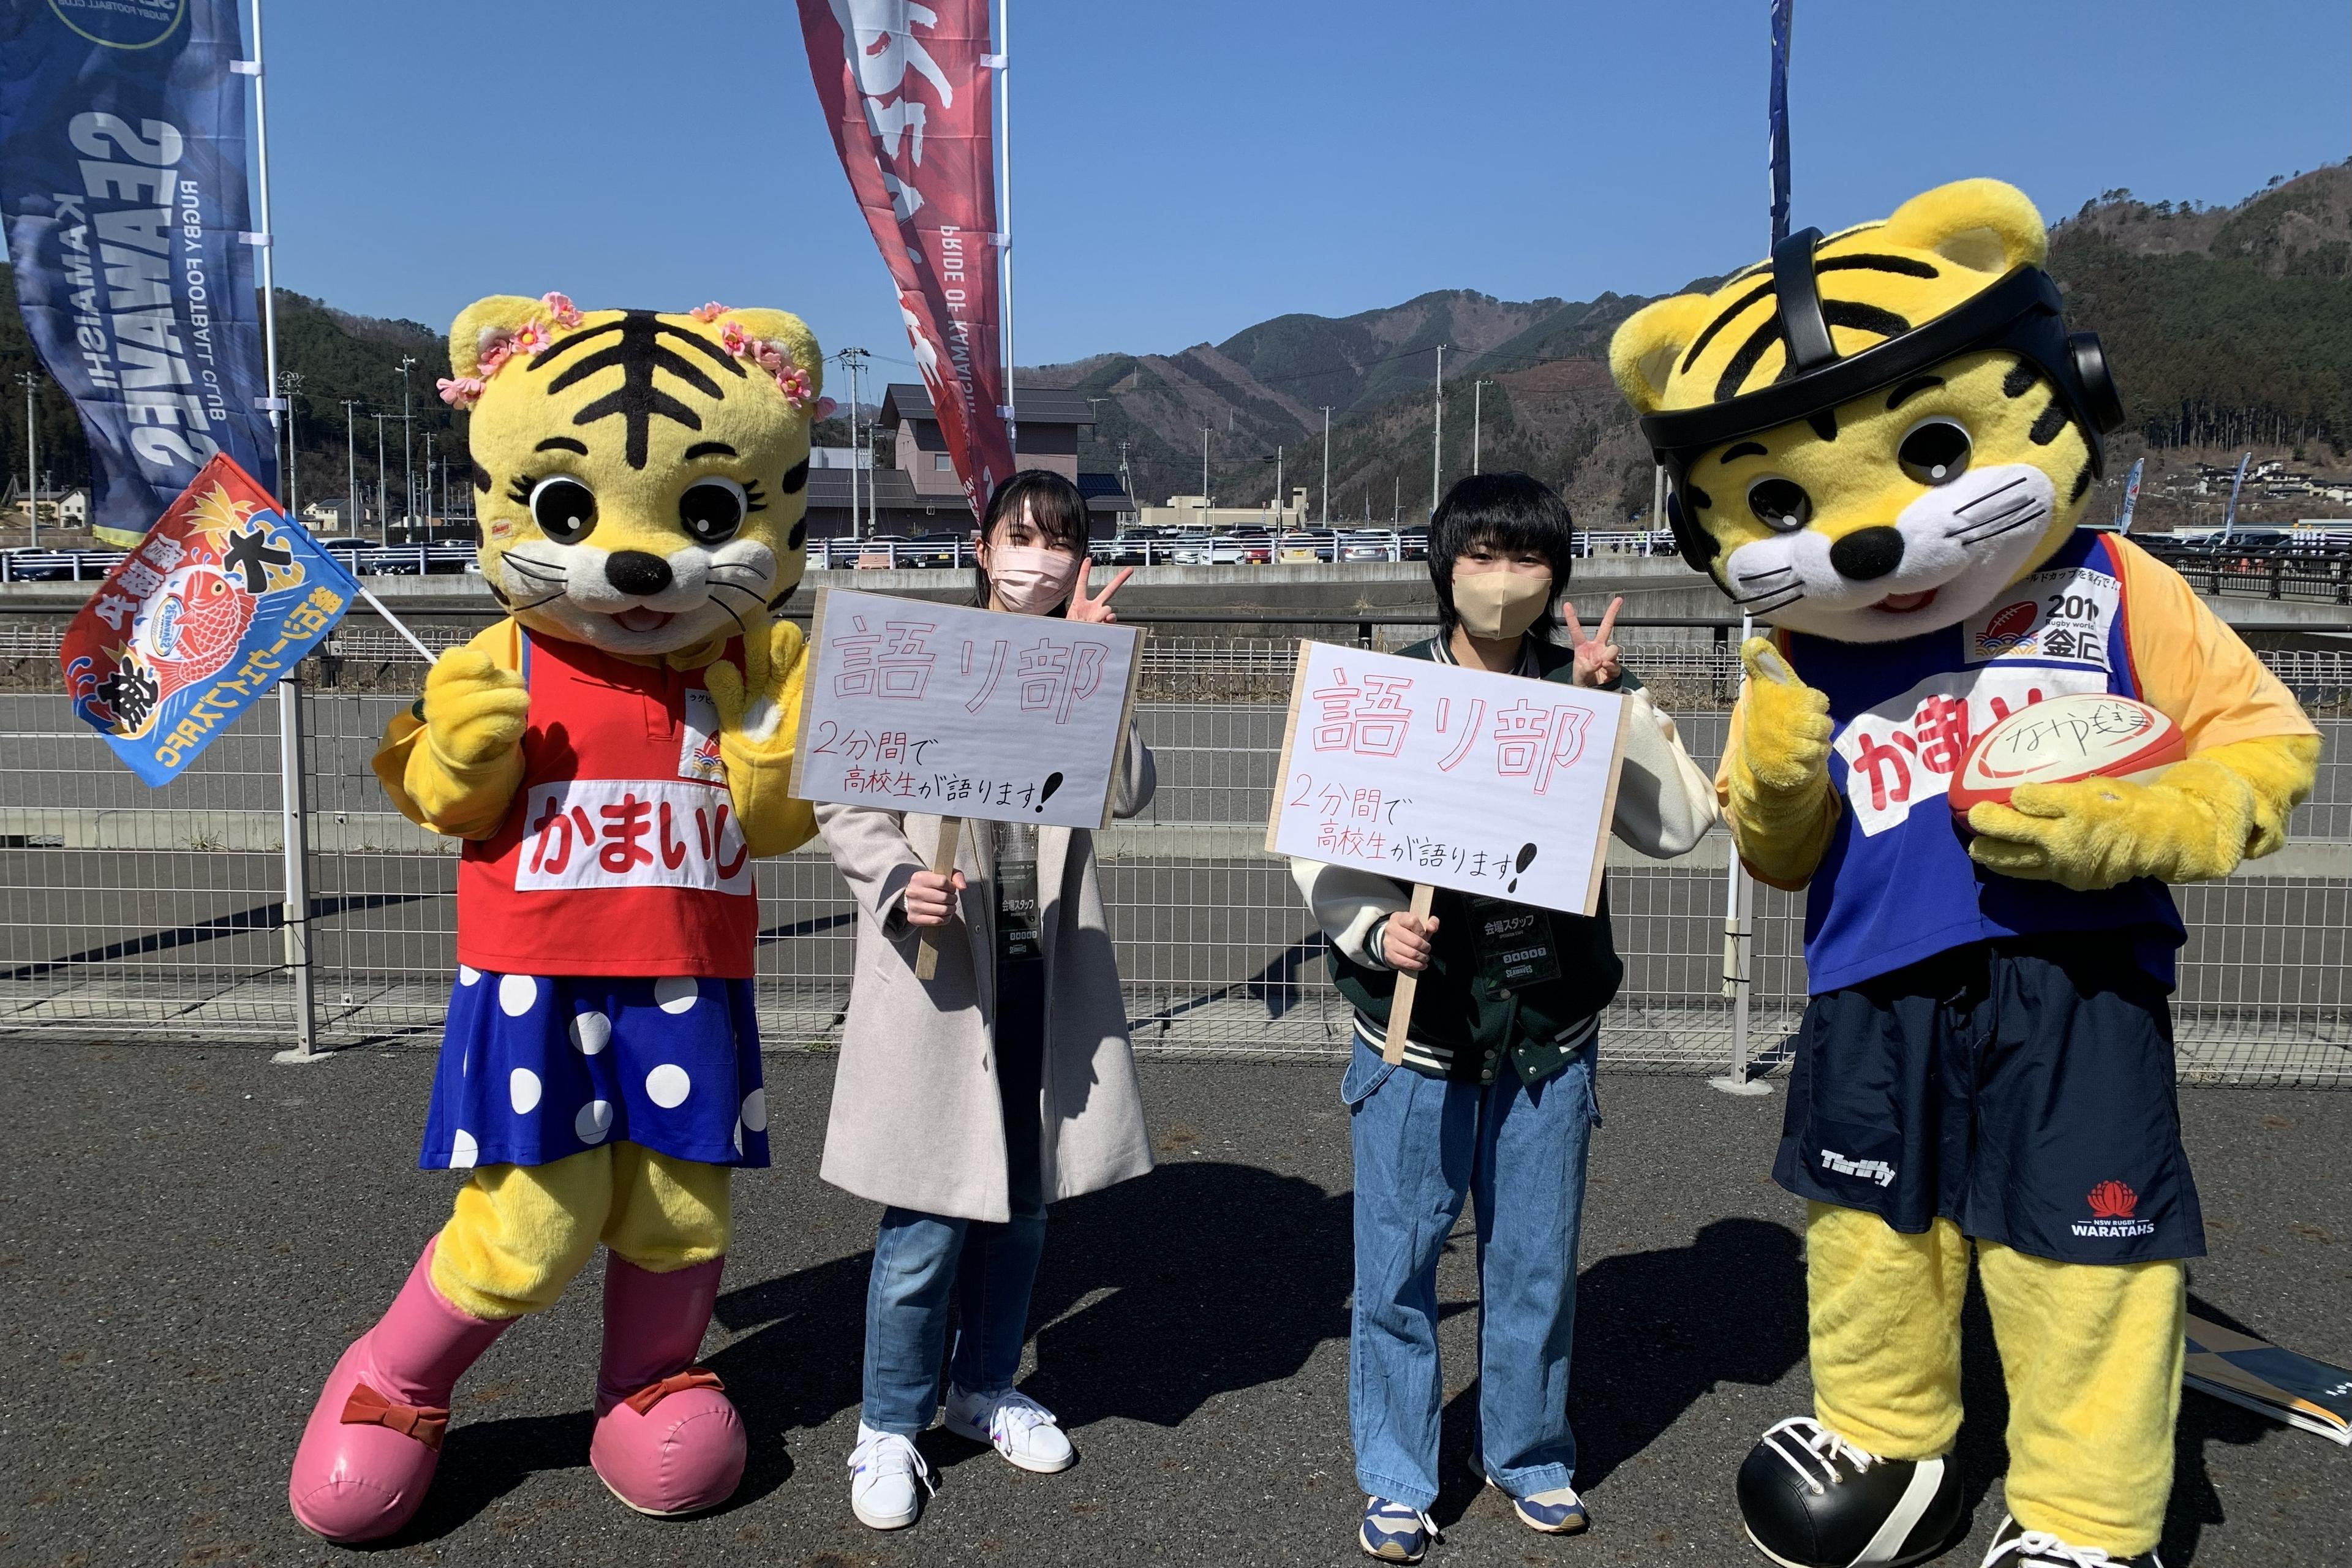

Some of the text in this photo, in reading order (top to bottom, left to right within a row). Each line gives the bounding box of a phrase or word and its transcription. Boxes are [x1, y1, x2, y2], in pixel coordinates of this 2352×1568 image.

[2046, 619, 2071, 628] Rugby
[813, 720, 938, 766] 2分間で
[1290, 774, 1414, 825] 2分間で
[529, 793, 748, 880] かまいし
[1002, 899, 1034, 912] 会場スタッフ
[1484, 915, 1534, 935] 会場スタッフ
[1820, 1149, 1896, 1188] Thrifty
[2071, 1223, 2154, 1237] WARATAHS
